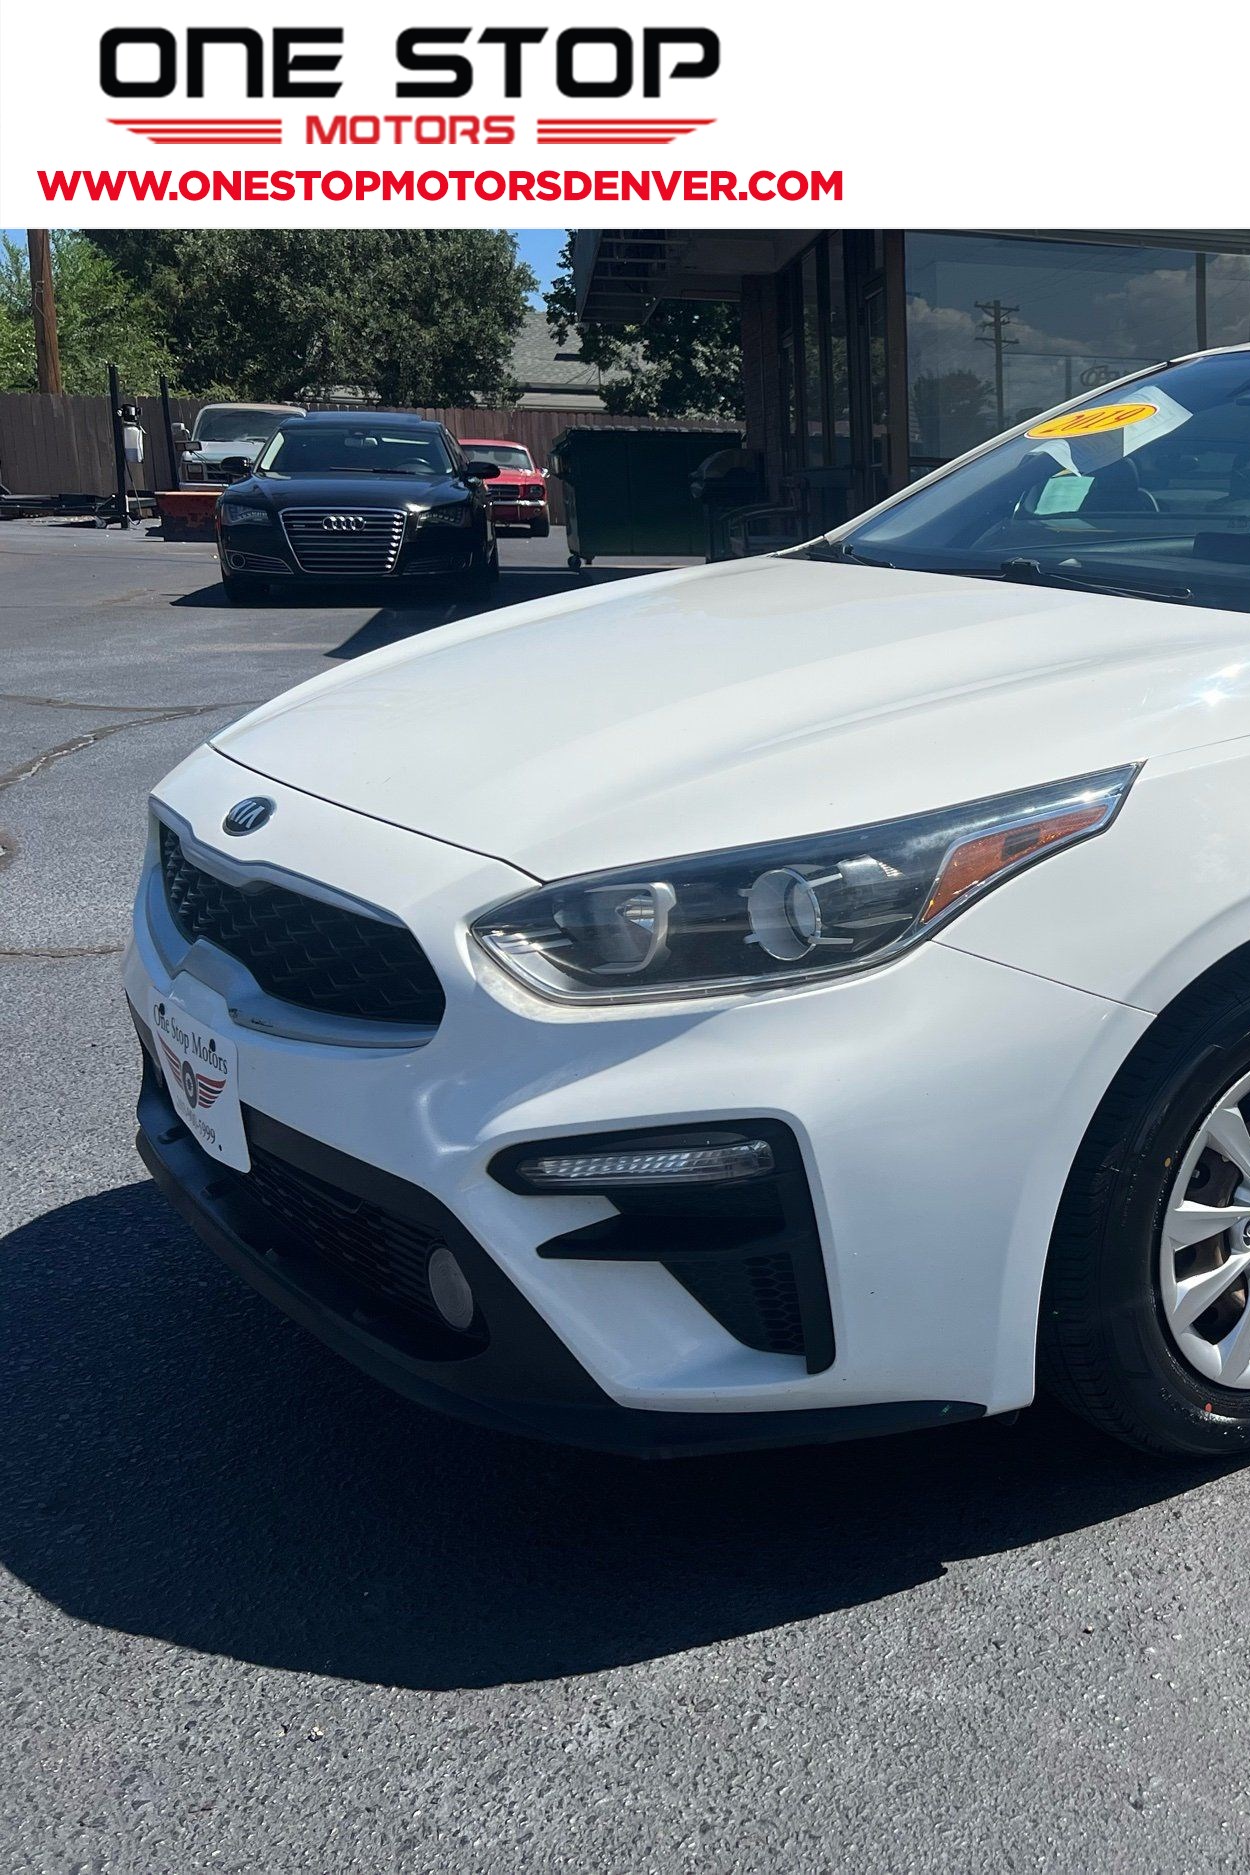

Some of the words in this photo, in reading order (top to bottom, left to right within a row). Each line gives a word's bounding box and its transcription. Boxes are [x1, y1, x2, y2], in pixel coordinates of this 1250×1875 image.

[1038, 406, 1147, 434] 2019
[153, 1003, 170, 1032] One
[170, 1019, 190, 1054] Stop
[192, 1033, 228, 1075] Motors
